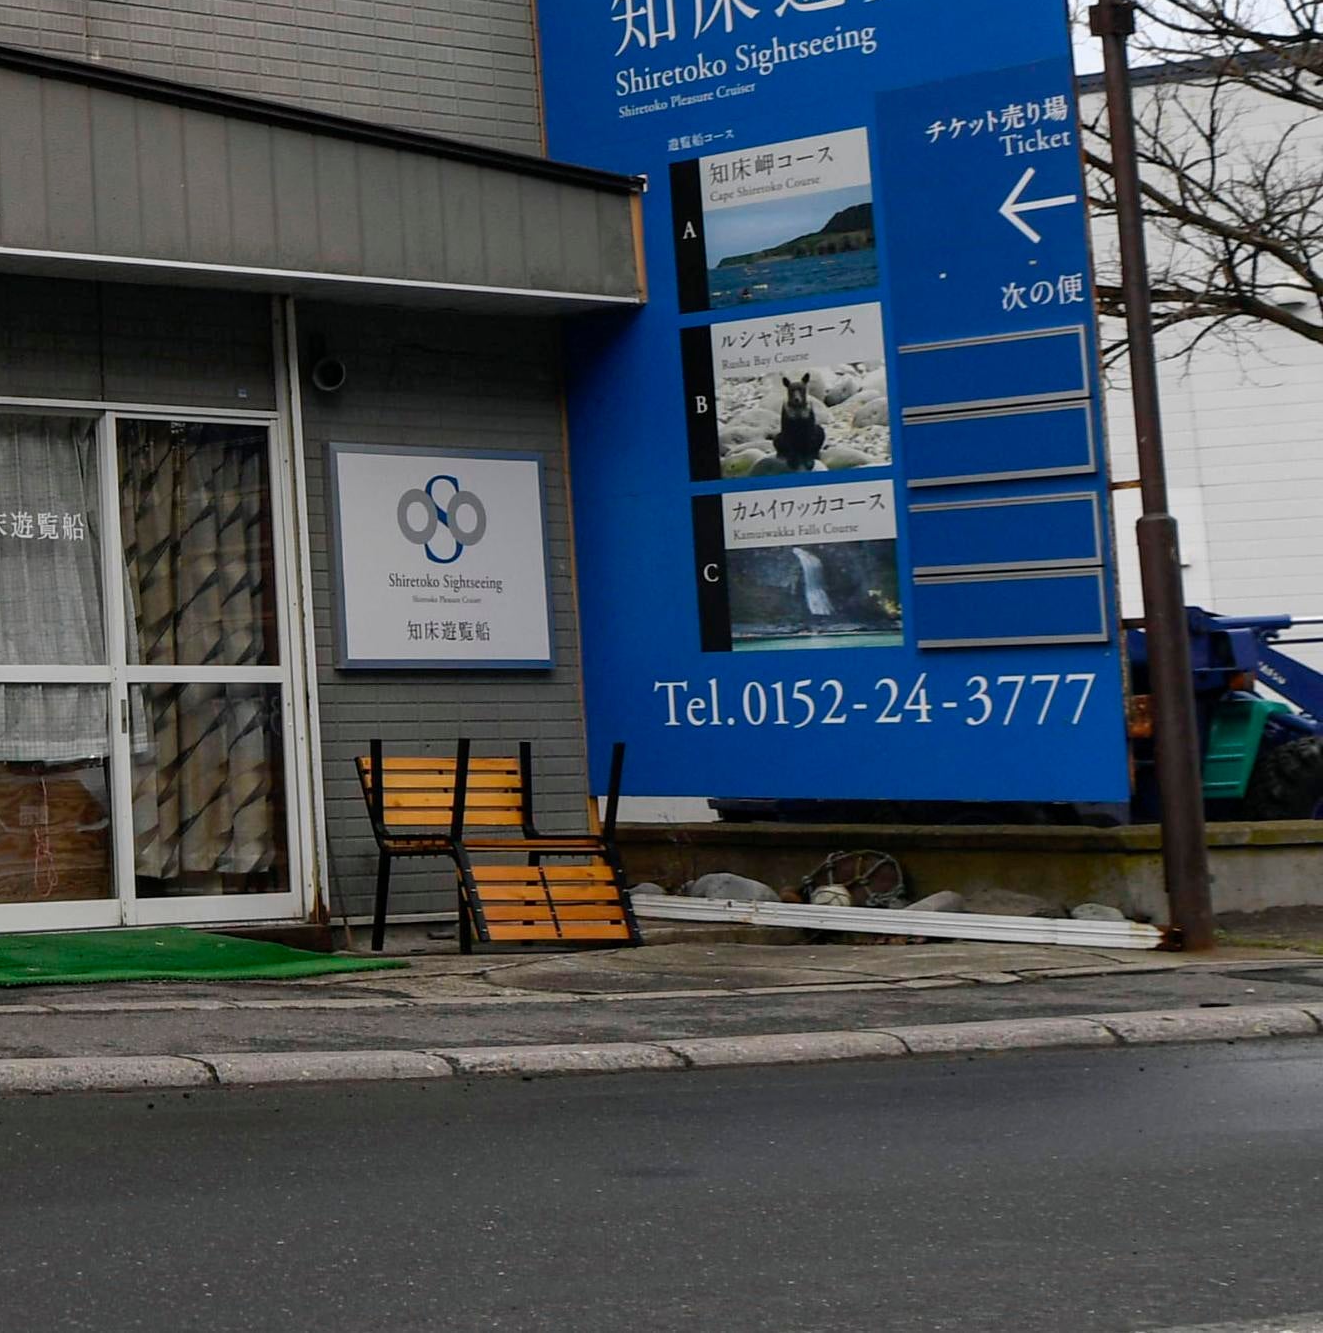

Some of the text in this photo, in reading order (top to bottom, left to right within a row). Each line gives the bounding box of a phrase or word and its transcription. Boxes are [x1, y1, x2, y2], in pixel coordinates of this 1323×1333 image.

[615, 24, 878, 97] Shiretoko Sightseeing
[618, 82, 756, 119] Shiretoko Pleasure Cruiser
[925, 96, 1069, 144] チケット売り場
[998, 129, 1072, 158] Ticket
[708, 145, 835, 186] 知床岬コース
[709, 175, 821, 204] Cape Shiretoko Course
[681, 221, 698, 241] A
[1000, 272, 1086, 313] 次の便
[721, 317, 856, 349] ルシャ湾コース
[753, 354, 772, 368] Bay
[774, 351, 810, 364] Course
[695, 396, 708, 414] B
[731, 493, 886, 522] カムイワッカコース
[732, 522, 860, 542] Kamuiwakka Falls Course
[388, 572, 503, 593] Shiretoko Sightseeing
[702, 564, 719, 583] C
[406, 620, 491, 642] 知床遊覧船
[653, 672, 1097, 730] Tel.0152-24-3777
